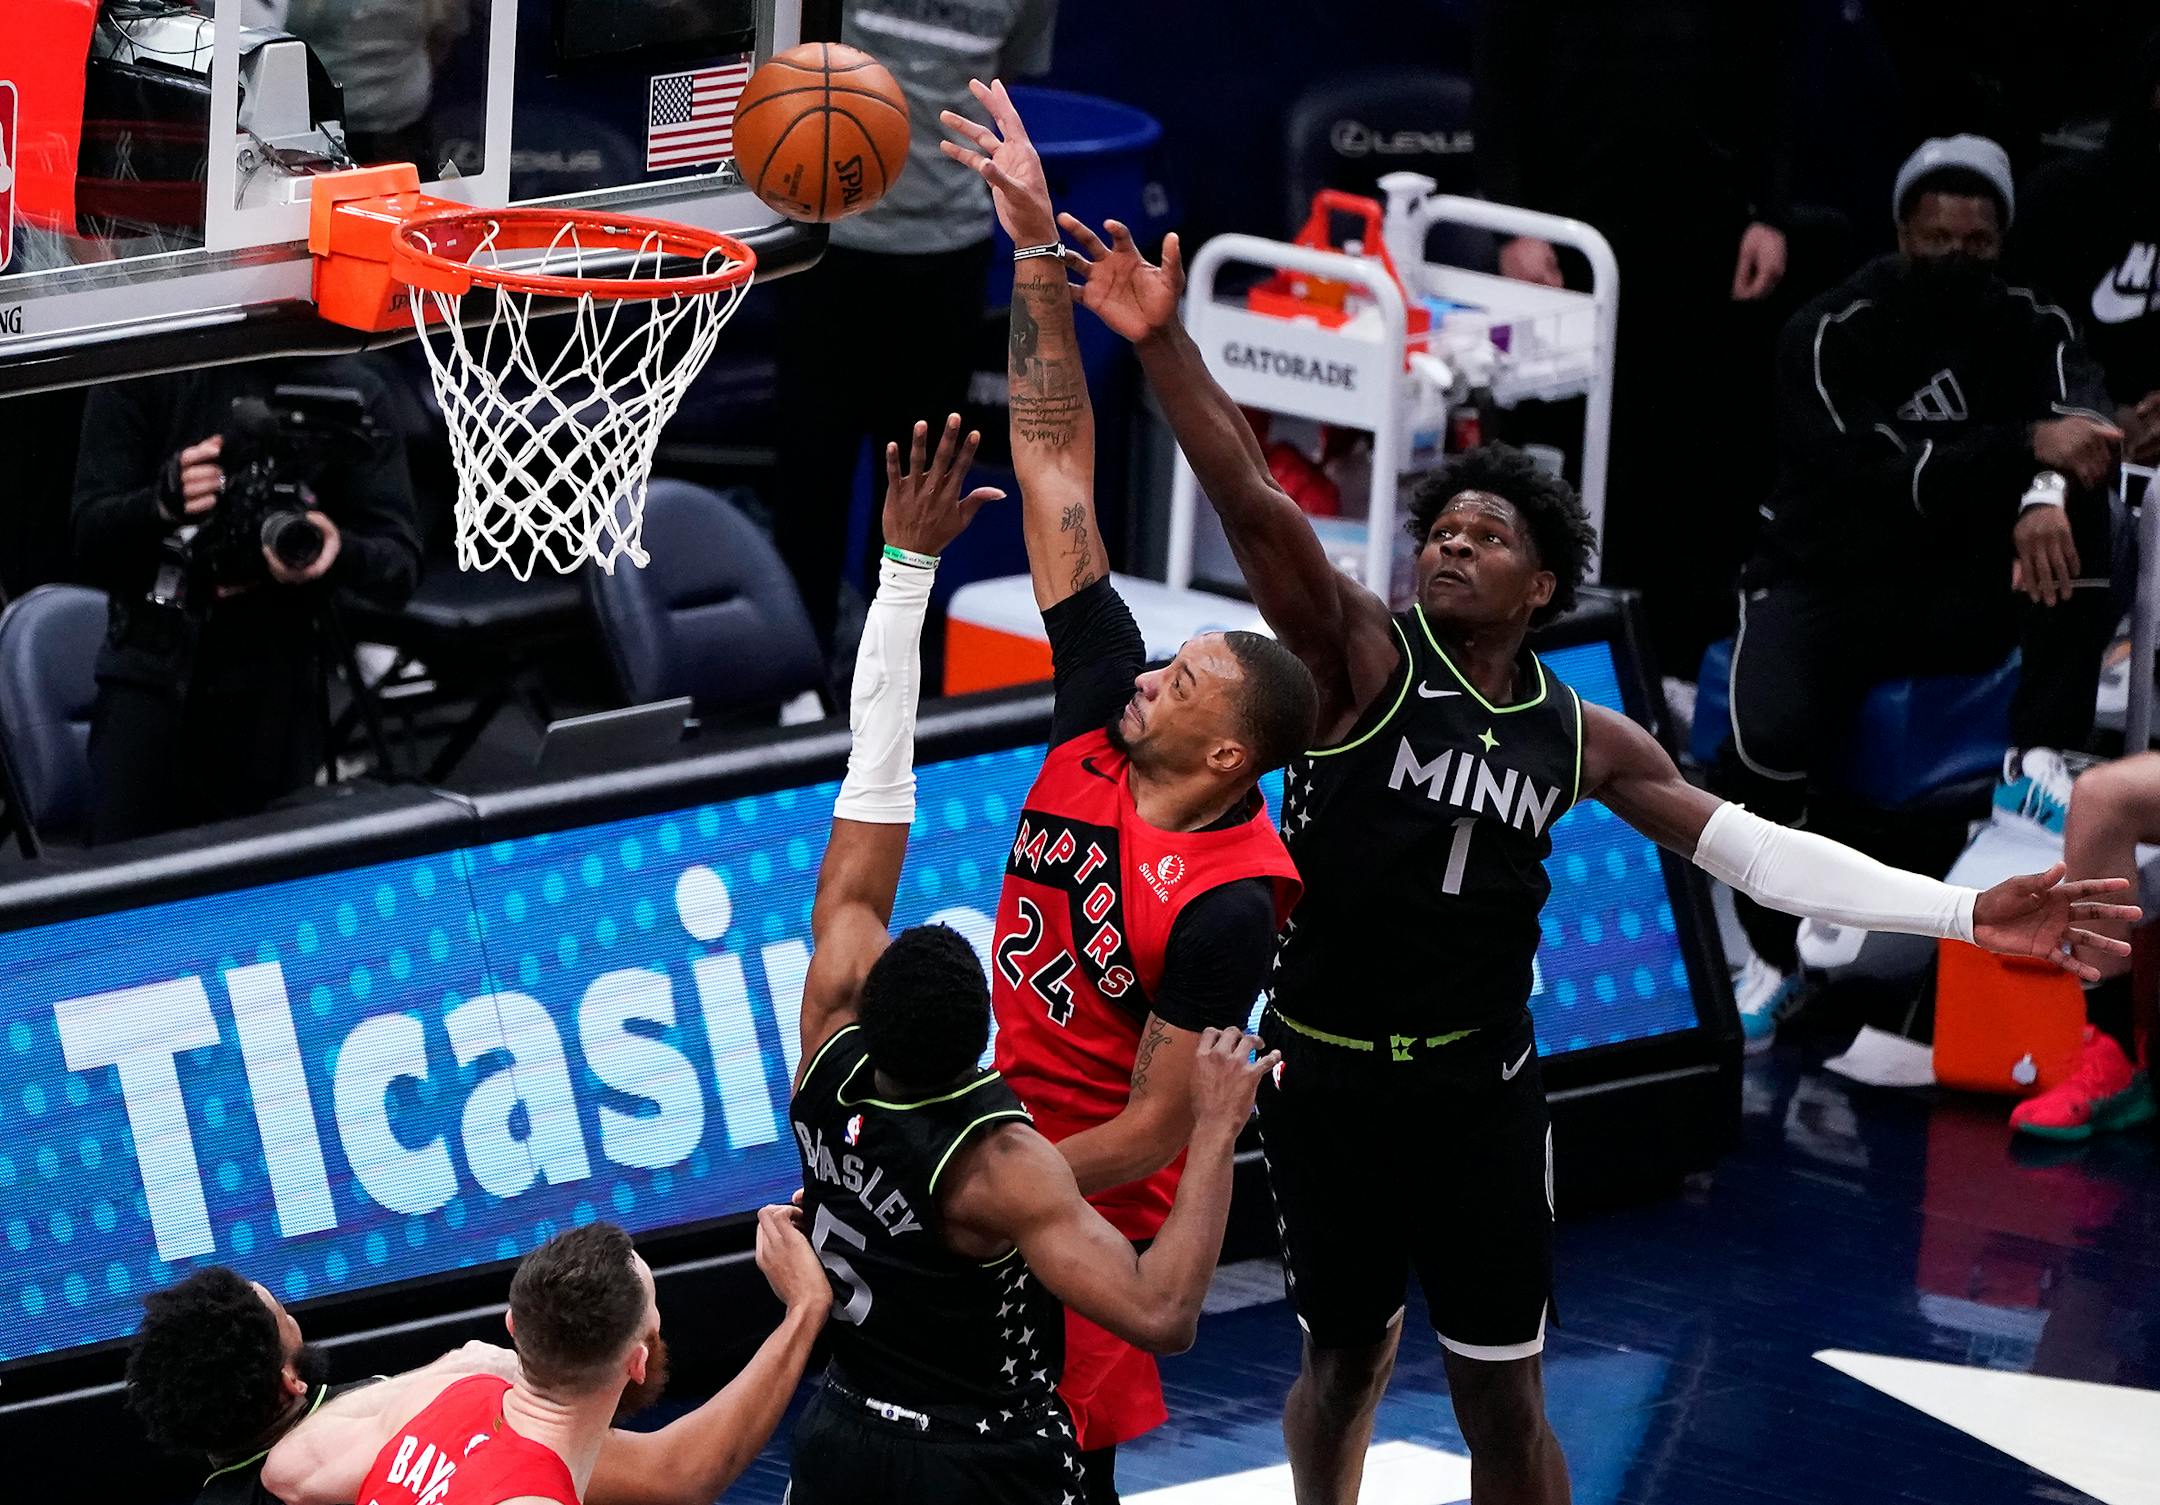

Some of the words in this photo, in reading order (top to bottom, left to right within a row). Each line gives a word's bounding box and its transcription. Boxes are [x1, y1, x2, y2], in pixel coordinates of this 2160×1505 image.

[1222, 342, 1357, 391] GATORADE
[1388, 736, 1560, 838] MINN
[1139, 863, 1156, 885] Sun
[1153, 882, 1169, 903] Life
[1442, 817, 1479, 895] 1
[1014, 819, 1135, 998] RAPTORS
[996, 897, 1077, 1027] 24
[811, 1203, 873, 1326] 5
